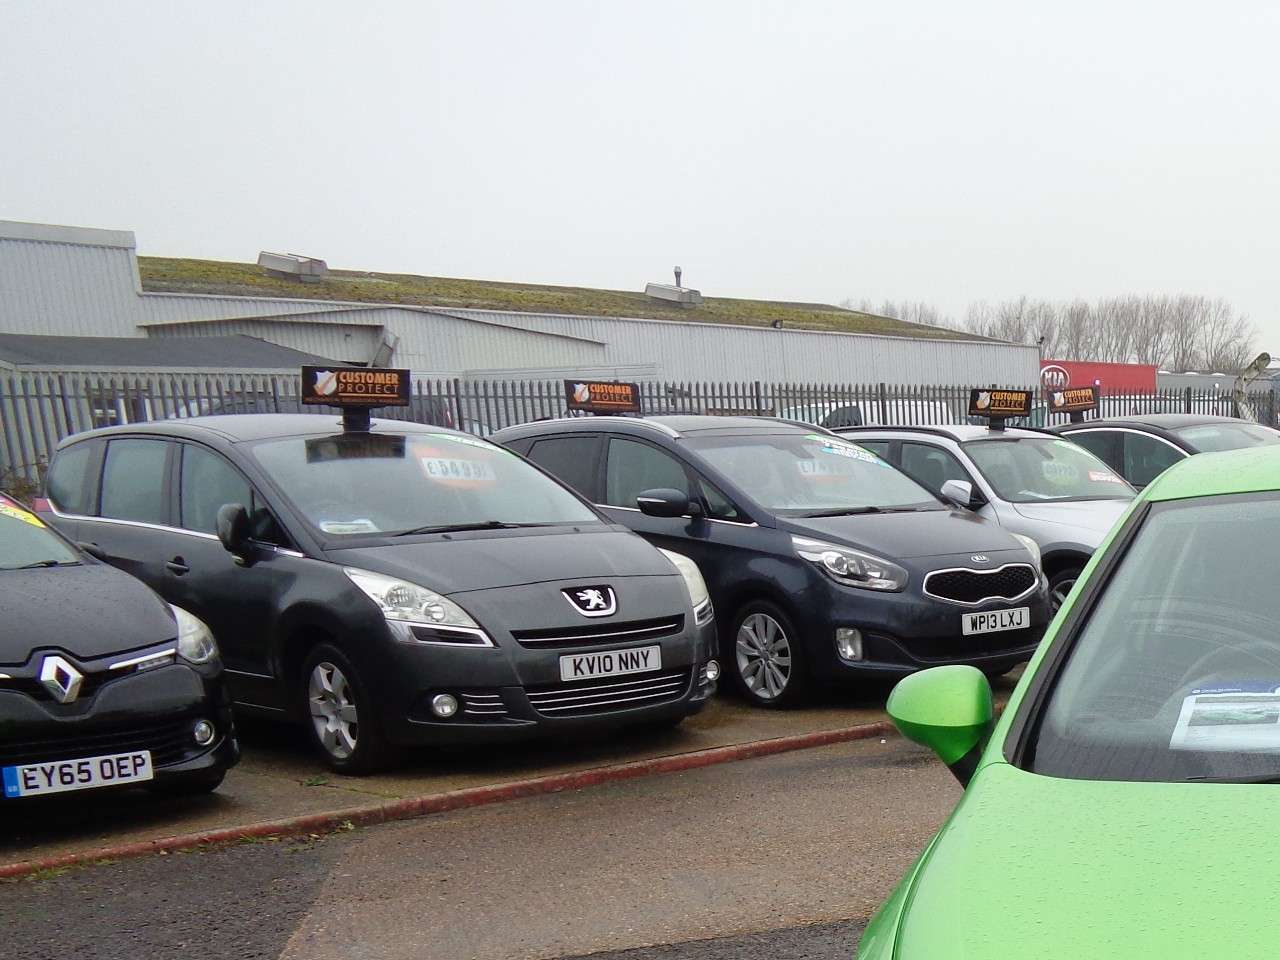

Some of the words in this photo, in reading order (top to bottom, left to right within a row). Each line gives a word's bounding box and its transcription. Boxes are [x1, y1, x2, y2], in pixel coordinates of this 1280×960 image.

[340, 371, 399, 384] CUSTOMER
[338, 383, 398, 393] PROTECT
[590, 383, 632, 395] CUSTOMER
[992, 391, 1026, 400] CUSTOMER
[970, 614, 997, 631] WP13
[1000, 610, 1023, 628] LXJ
[573, 655, 613, 676] KV10
[618, 650, 650, 671] NNY
[22, 761, 92, 789] EY65
[99, 754, 146, 780] OEP
